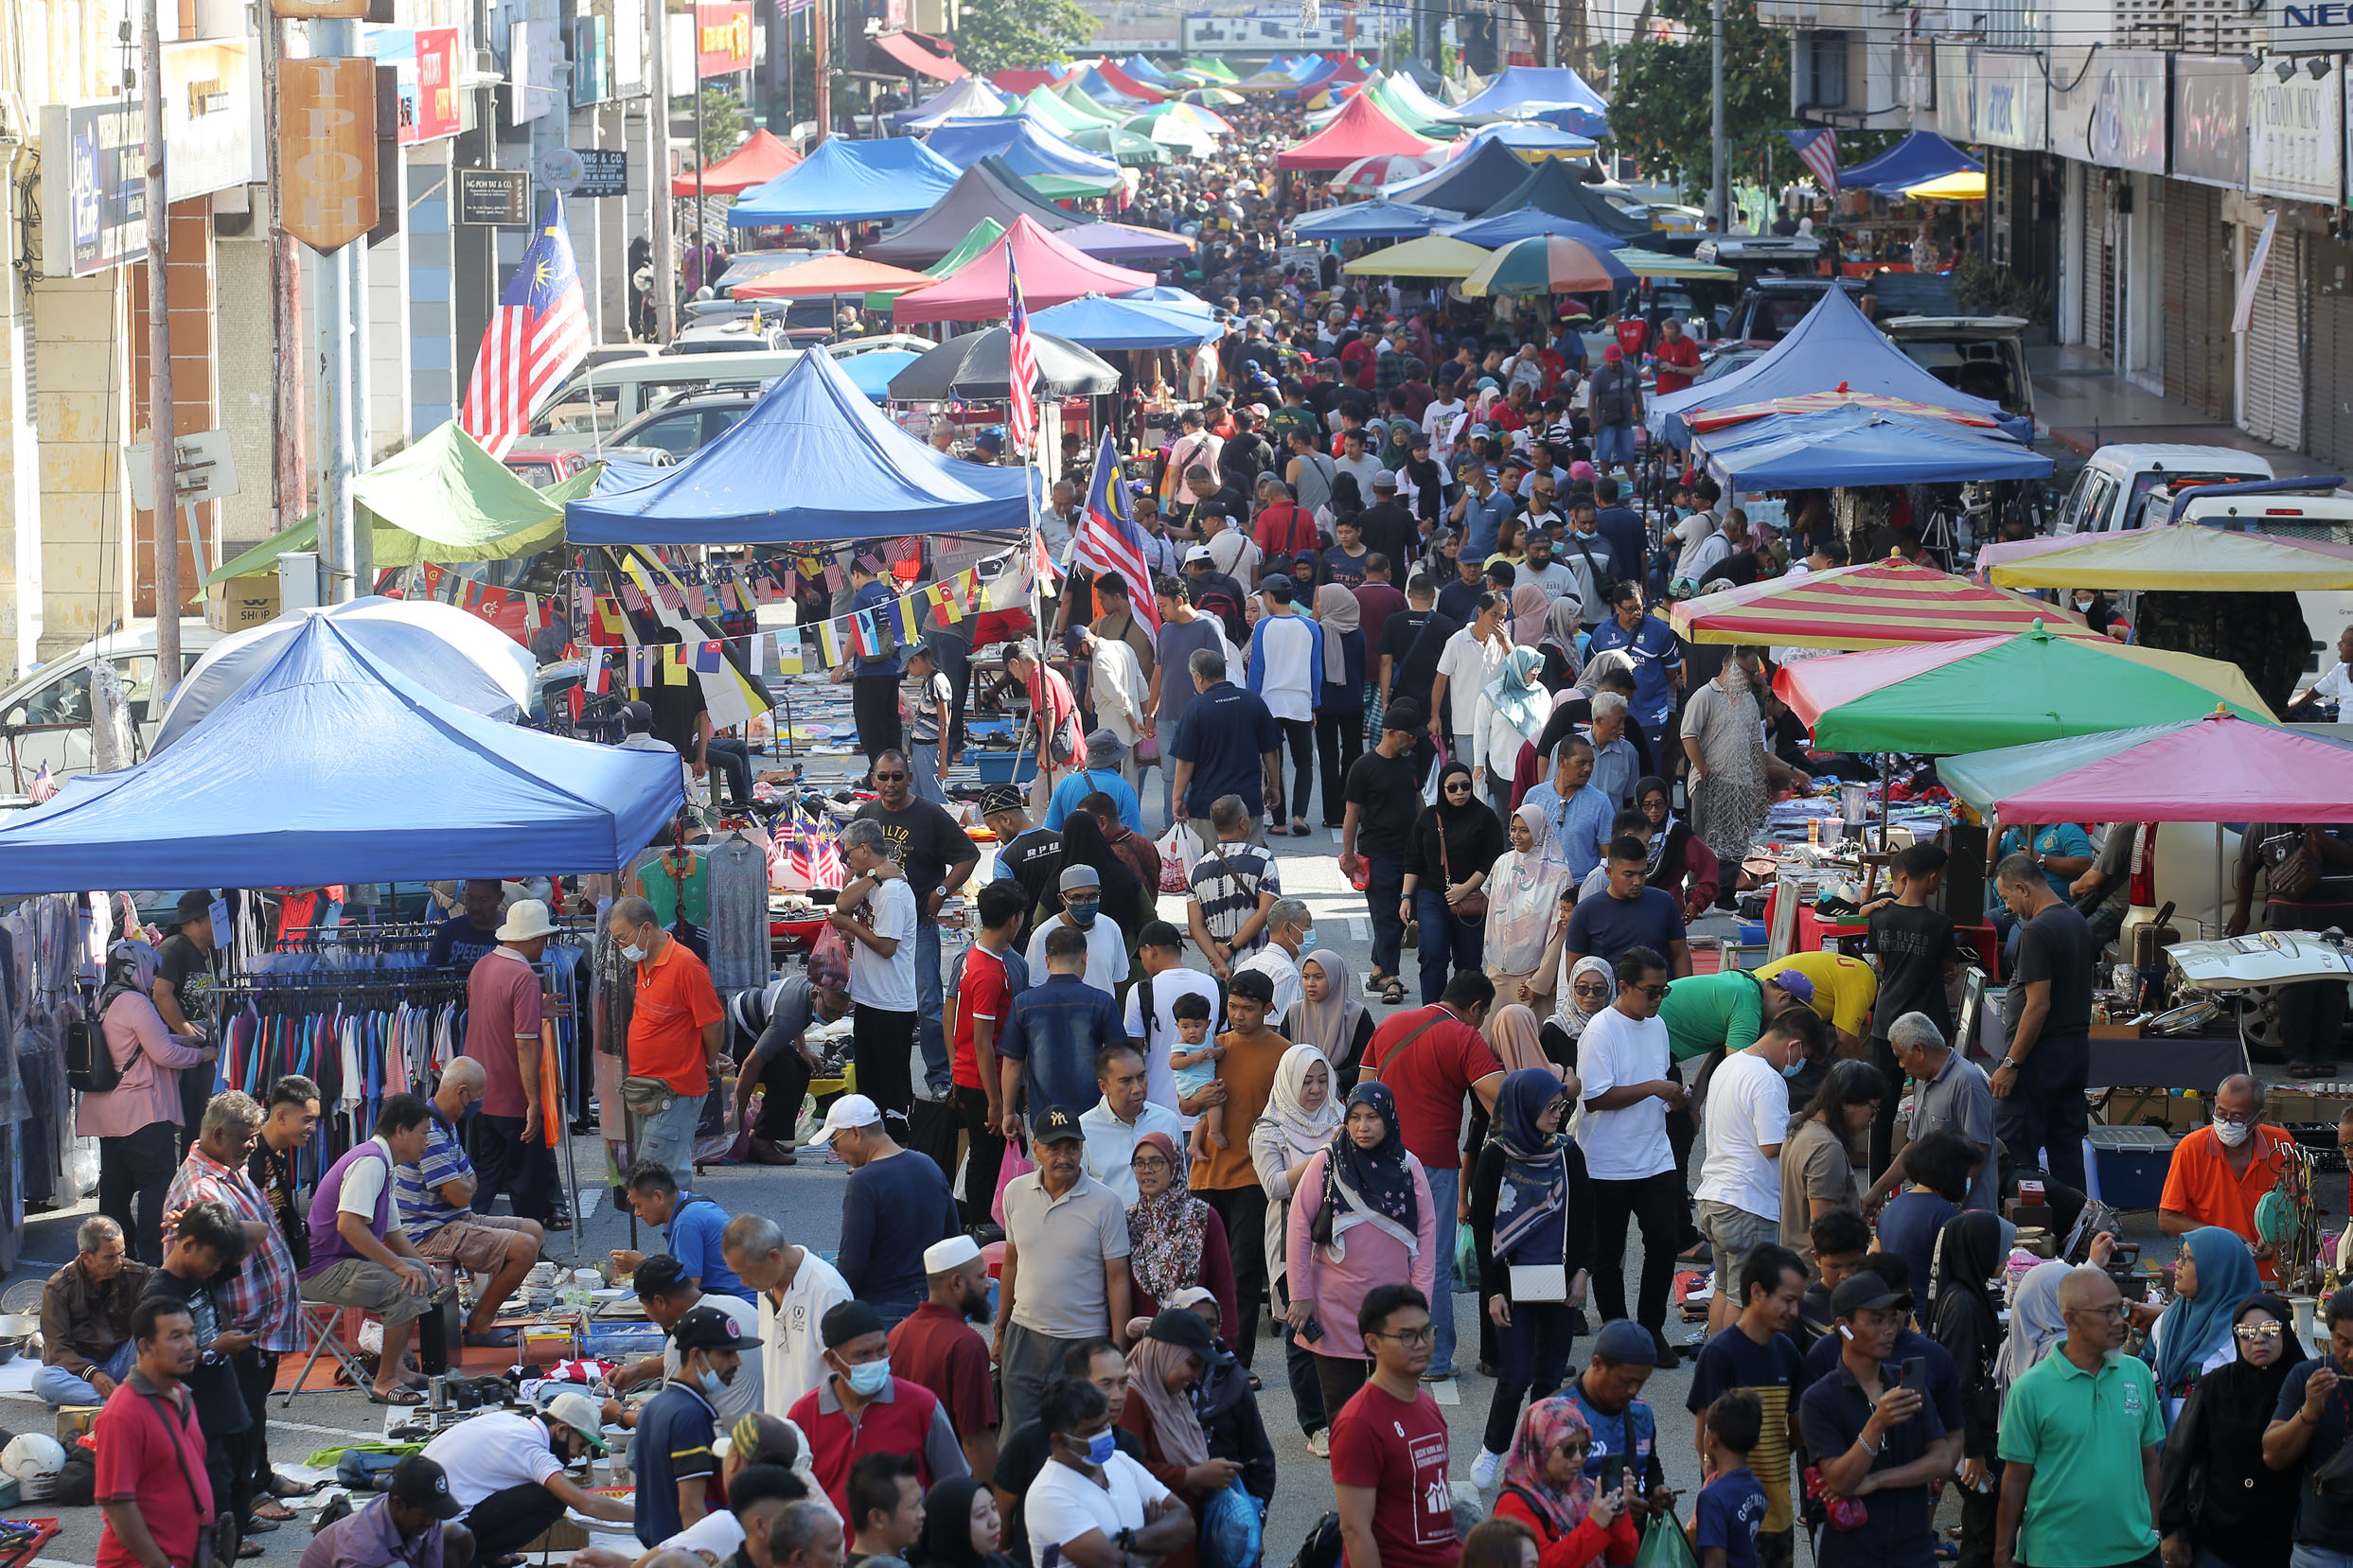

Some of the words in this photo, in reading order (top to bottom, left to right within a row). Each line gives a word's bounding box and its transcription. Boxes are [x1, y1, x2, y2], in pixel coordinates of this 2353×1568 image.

[2284, 3, 2353, 27] NE
[295, 66, 364, 226] IPOH
[577, 152, 597, 164] ONG
[610, 153, 624, 164] CO.
[1333, 573, 1362, 583] ETIHA
[449, 940, 494, 963] SPEEDW
[1393, 1420, 1406, 1437] 8
